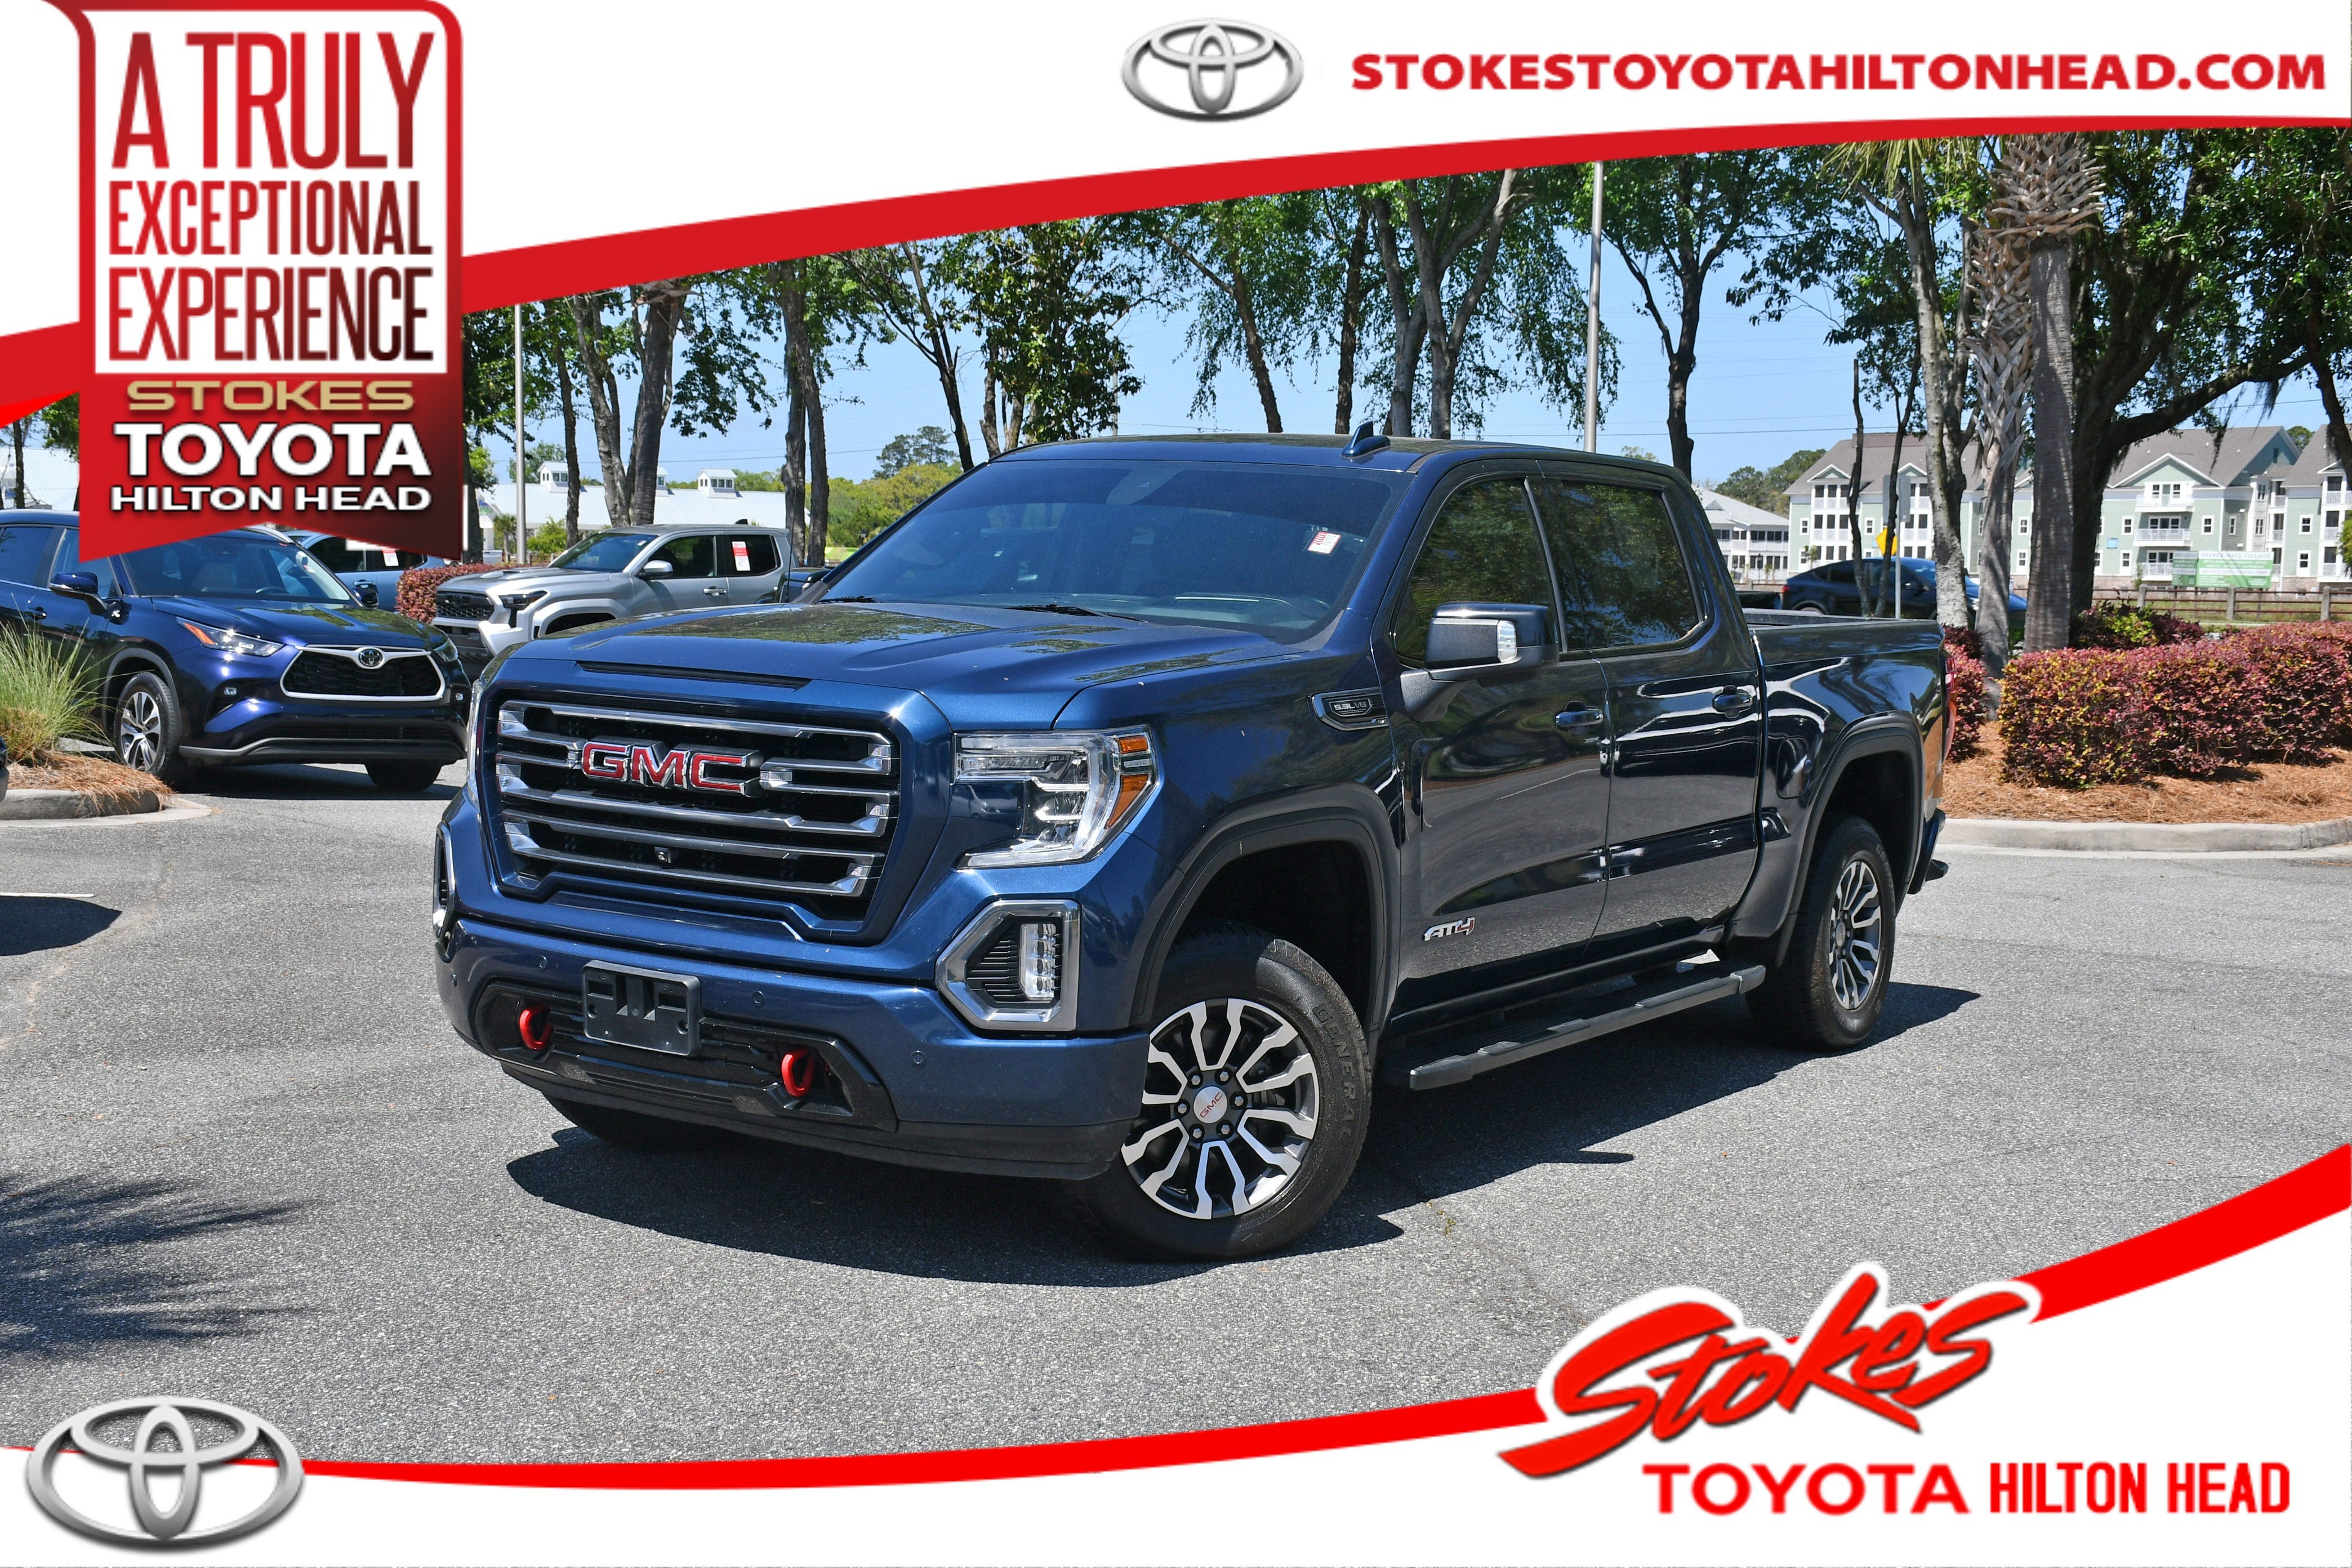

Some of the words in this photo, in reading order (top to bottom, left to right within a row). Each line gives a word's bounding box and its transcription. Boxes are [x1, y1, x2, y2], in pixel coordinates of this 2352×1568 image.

[582, 740, 760, 796] GMC
[1423, 917, 1475, 942] AT4
[1200, 1092, 1222, 1118] GMC
